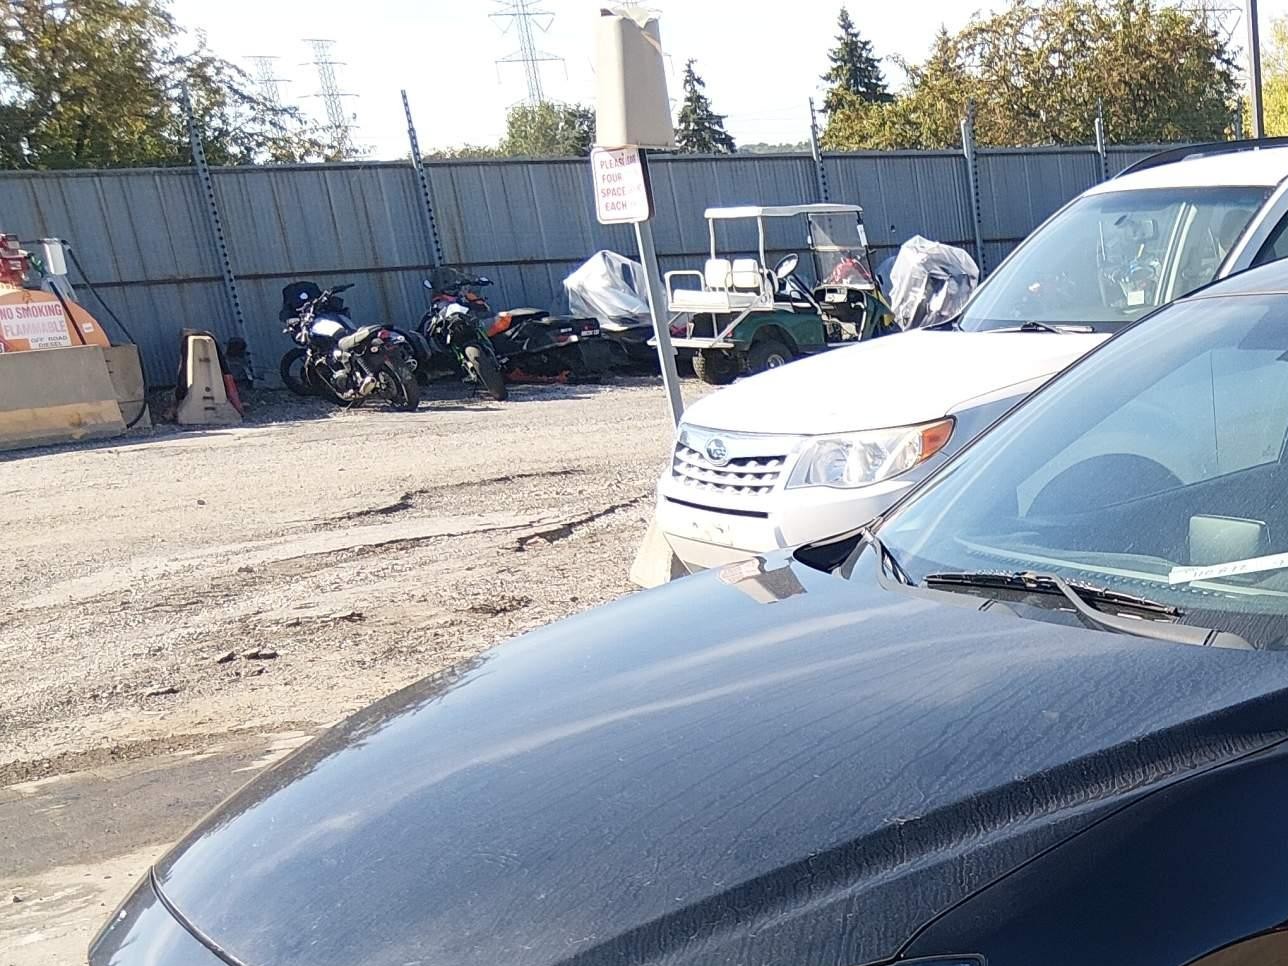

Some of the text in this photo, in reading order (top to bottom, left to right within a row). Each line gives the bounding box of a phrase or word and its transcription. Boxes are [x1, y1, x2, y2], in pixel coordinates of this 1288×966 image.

[602, 172, 622, 184] FOUR
[605, 200, 627, 211] EACH
[0, 303, 63, 320] NO SMOKING
[4, 321, 66, 337] FLAMMABLE
